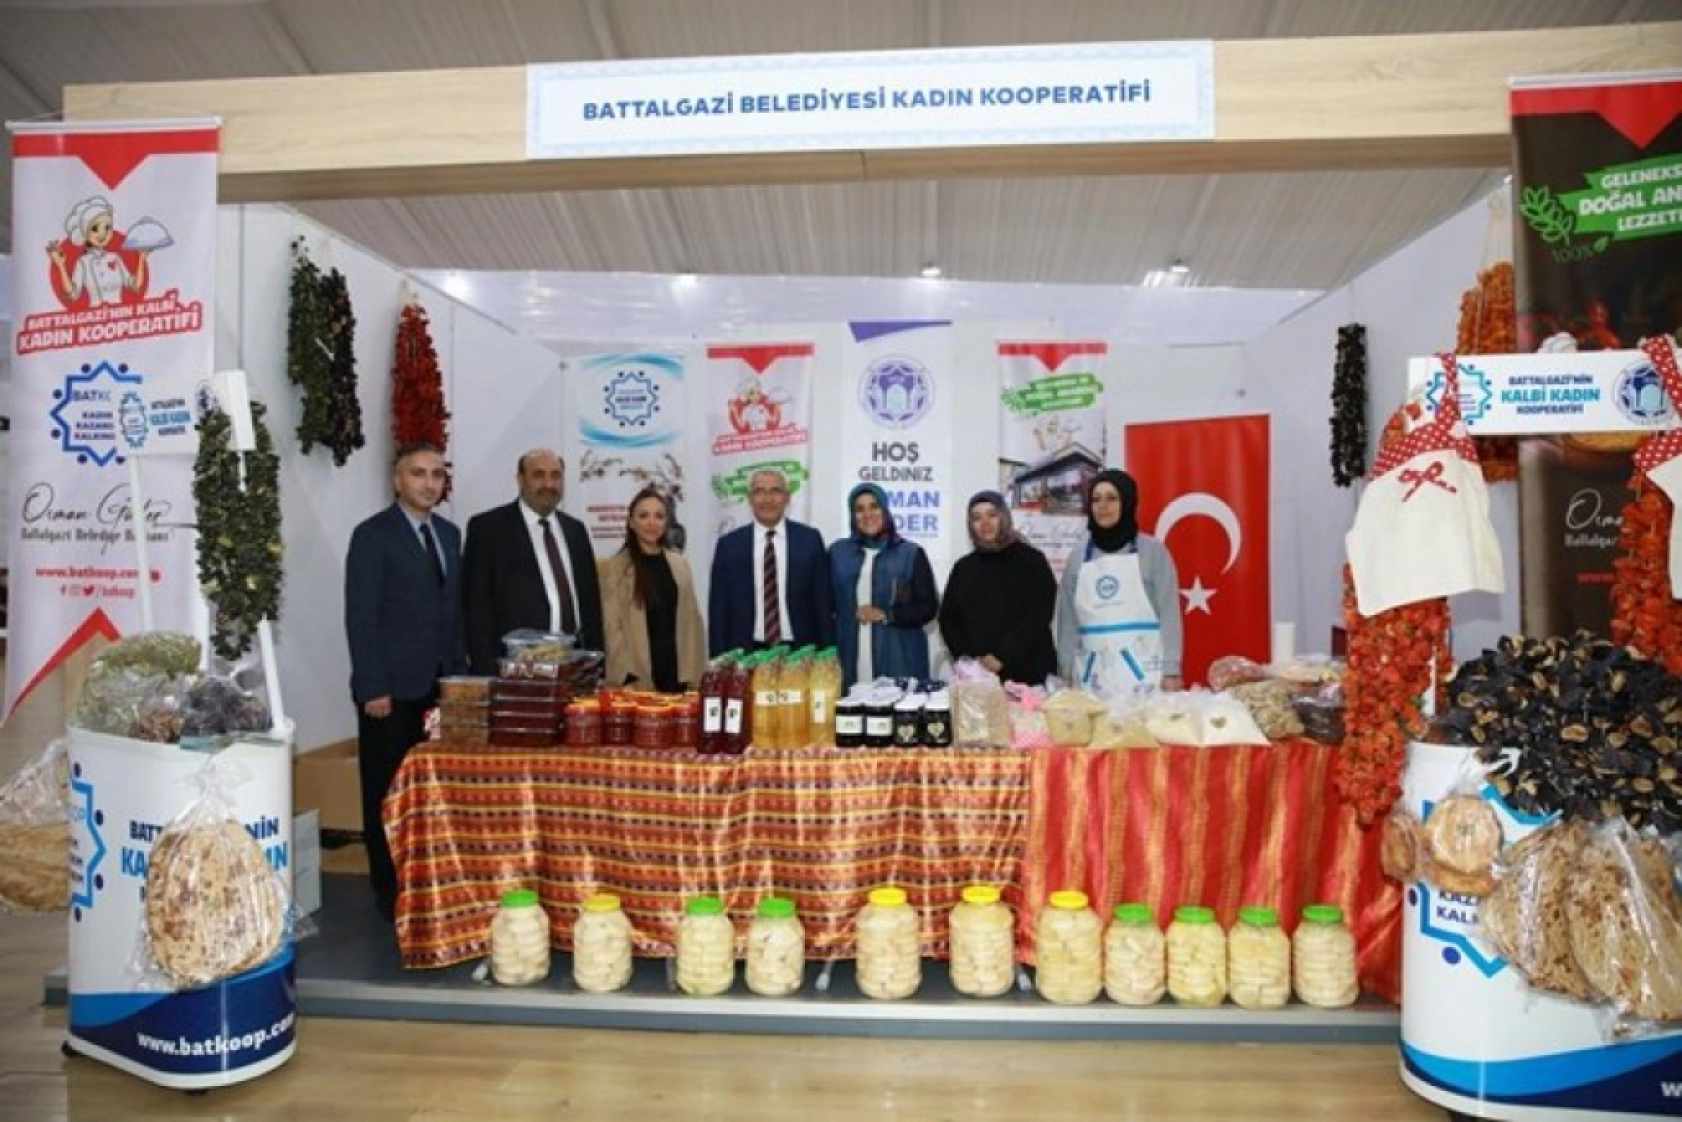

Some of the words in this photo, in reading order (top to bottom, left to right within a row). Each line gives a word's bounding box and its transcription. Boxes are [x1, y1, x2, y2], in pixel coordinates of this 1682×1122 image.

[583, 91, 734, 120] BATTALGAZİ
[740, 86, 886, 114] BELEDİYESİ
[892, 88, 973, 108] KADIN
[980, 78, 1152, 106] KOOPERATİFİ
[1579, 188, 1647, 216] DOĞAL
[1501, 384, 1546, 402] KALBİ
[1551, 387, 1601, 402] KADIN
[871, 441, 919, 464] HOŞ
[885, 491, 940, 508] MAN
[892, 513, 940, 532] DER
